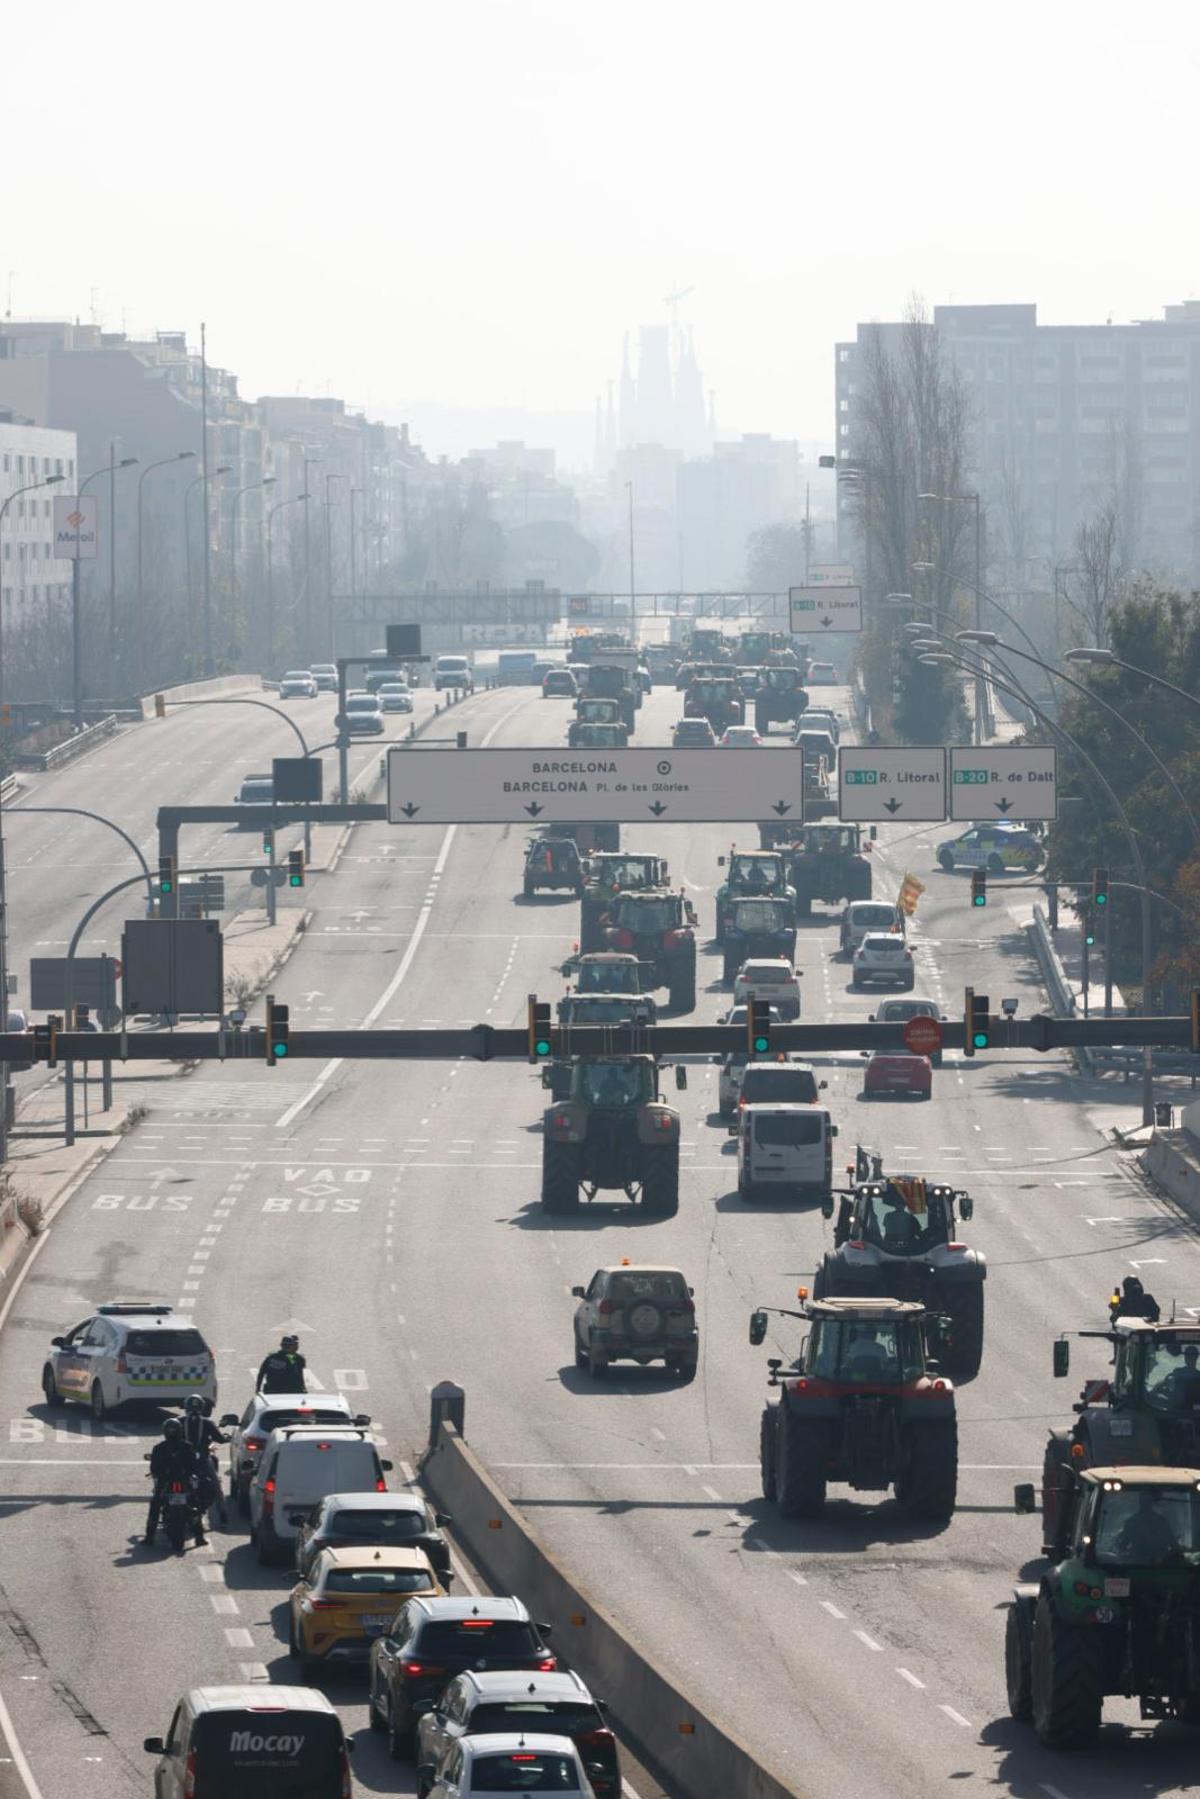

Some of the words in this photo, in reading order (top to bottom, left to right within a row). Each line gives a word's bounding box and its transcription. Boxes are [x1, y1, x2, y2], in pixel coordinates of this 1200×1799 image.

[532, 762, 617, 773] BARCELONA
[846, 772, 875, 783] B-10
[879, 772, 892, 783] R.
[897, 772, 940, 783] Litoral
[955, 771, 986, 783] B-20
[991, 772, 1003, 783] R.
[1007, 772, 1023, 783] de
[1028, 772, 1054, 783] Dalt
[503, 781, 588, 792] BARCELONA
[615, 783, 628, 792] de
[632, 783, 648, 792] les
[284, 1169, 372, 1183] VAO
[91, 1195, 193, 1210] BUS
[261, 1198, 361, 1213] BUS
[229, 1731, 305, 1757] Mocay
